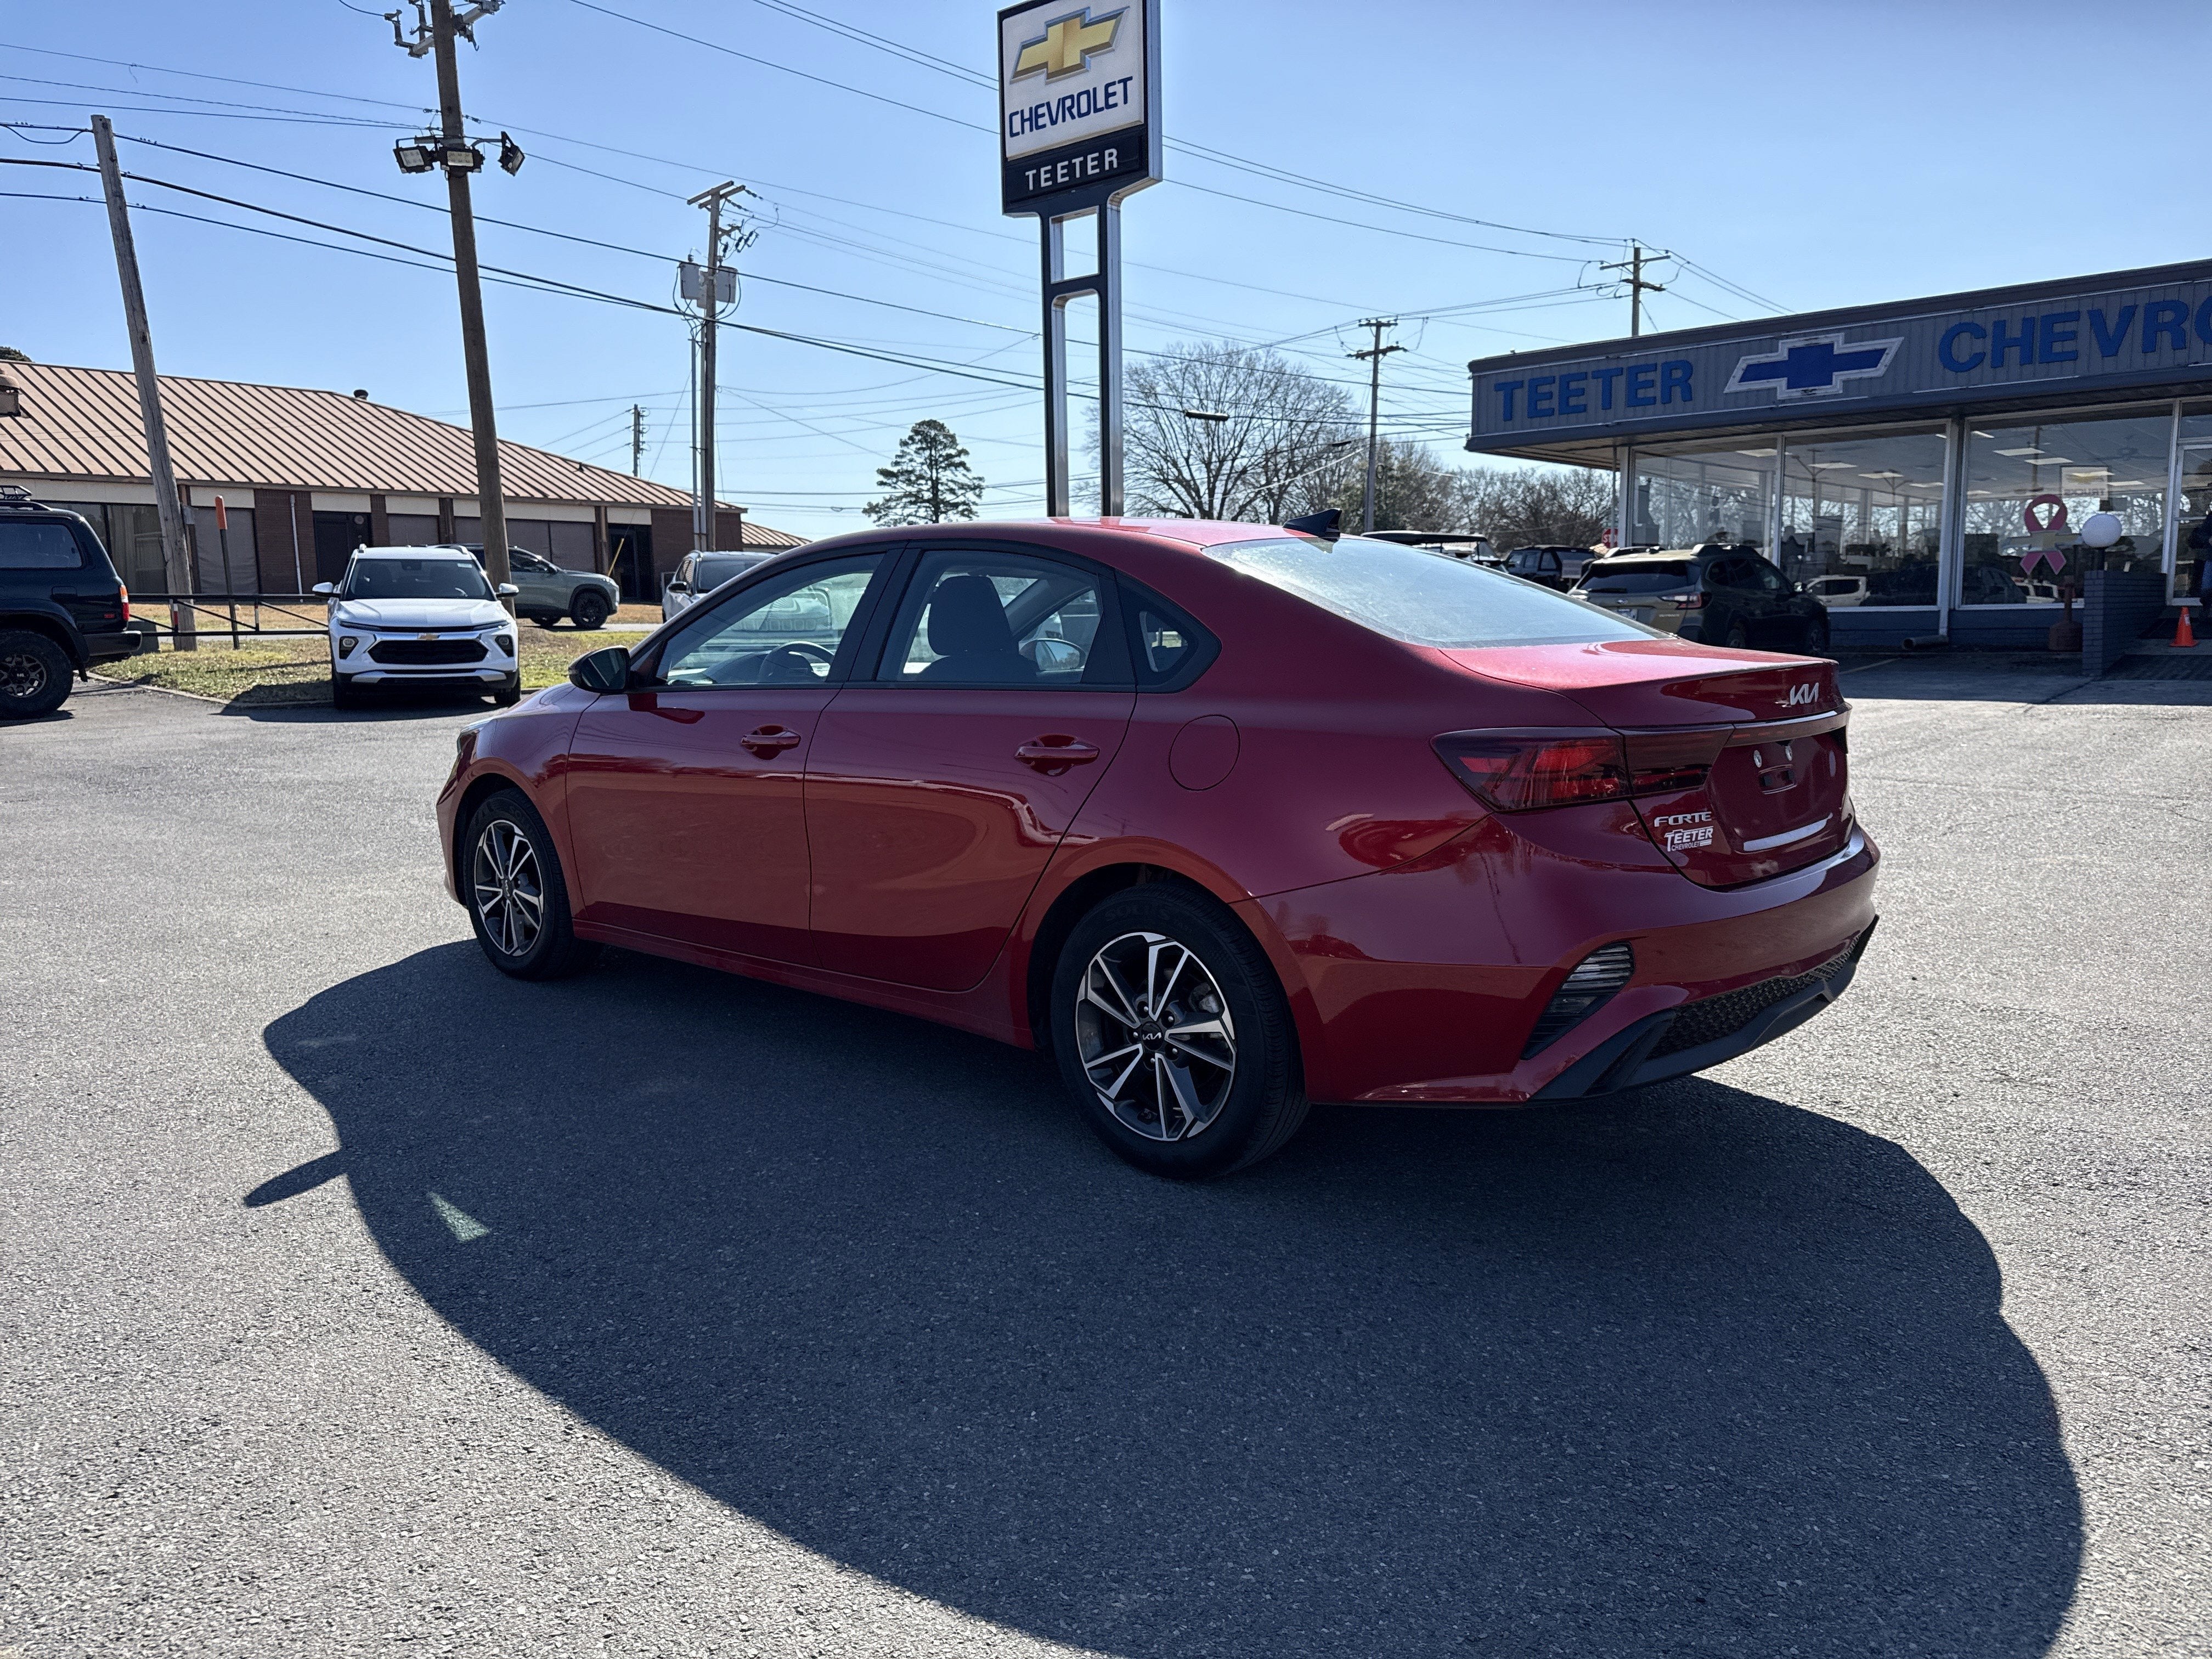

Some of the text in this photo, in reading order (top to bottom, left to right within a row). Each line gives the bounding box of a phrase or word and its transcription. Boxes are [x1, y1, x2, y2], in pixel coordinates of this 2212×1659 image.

[1009, 76, 1133, 138] CHEVROLET
[1025, 148, 1118, 190] TEETER
[1494, 359, 1693, 422] TEETER
[1654, 811, 1712, 827] FORTE
[1664, 827, 1713, 852] TEETER
[1671, 841, 1700, 851] CHEVROLET
